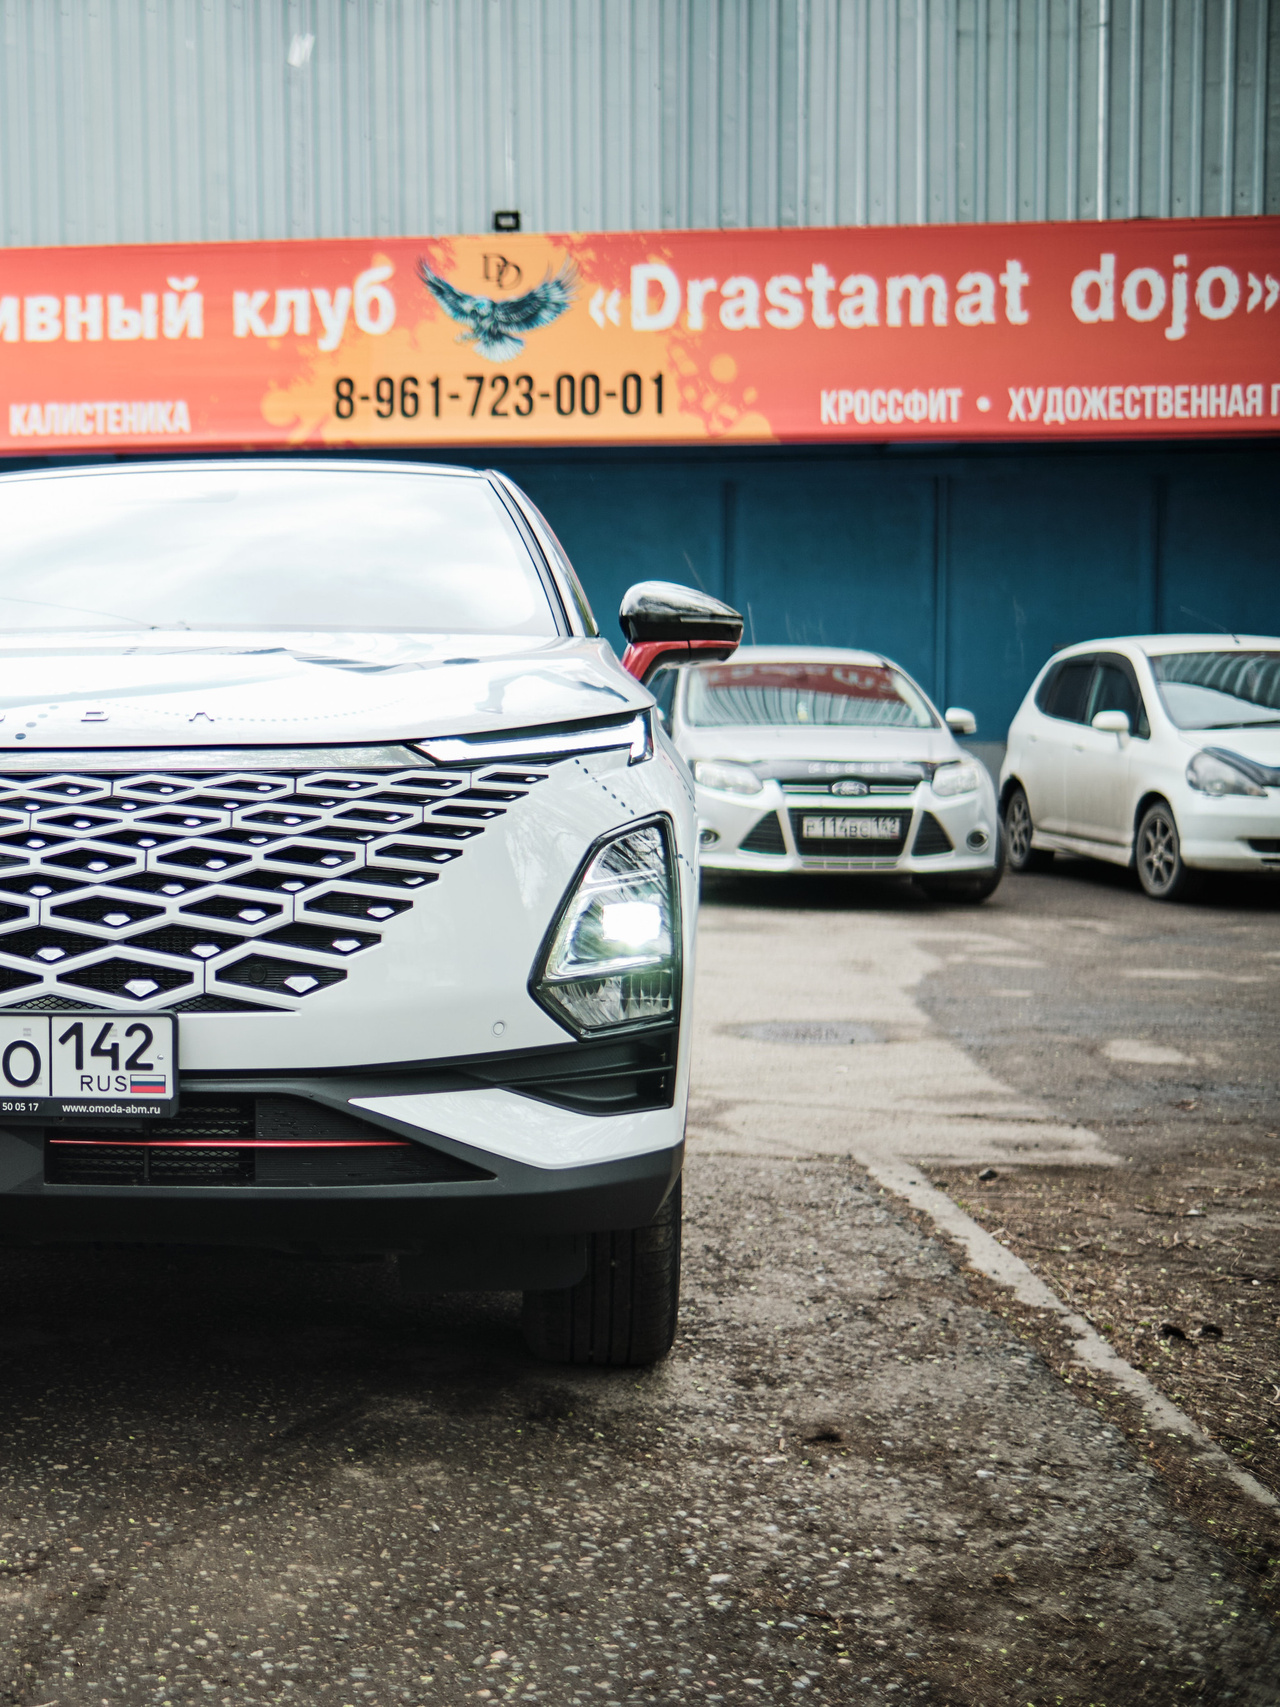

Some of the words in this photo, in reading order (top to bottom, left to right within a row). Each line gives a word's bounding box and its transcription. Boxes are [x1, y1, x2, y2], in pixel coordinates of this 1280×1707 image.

[233, 265, 395, 352] клуб
[587, 258, 1030, 332] «Drastamat
[1070, 253, 1280, 341] dojo»
[334, 372, 664, 420] 8-961-723-00-01
[820, 387, 963, 425] КРОССФИТ
[1007, 384, 1263, 425] ХУДОЖЕСТВЕННАЯ
[9, 400, 191, 437] КАЛИСТЕНИКА
[58, 1021, 155, 1071] 142
[80, 1074, 128, 1093] RUS
[2, 1102, 13, 1111] 50
[14, 1102, 26, 1111] 05
[28, 1102, 39, 1112] 17
[61, 1103, 161, 1115] www.omoda-abm.ru
